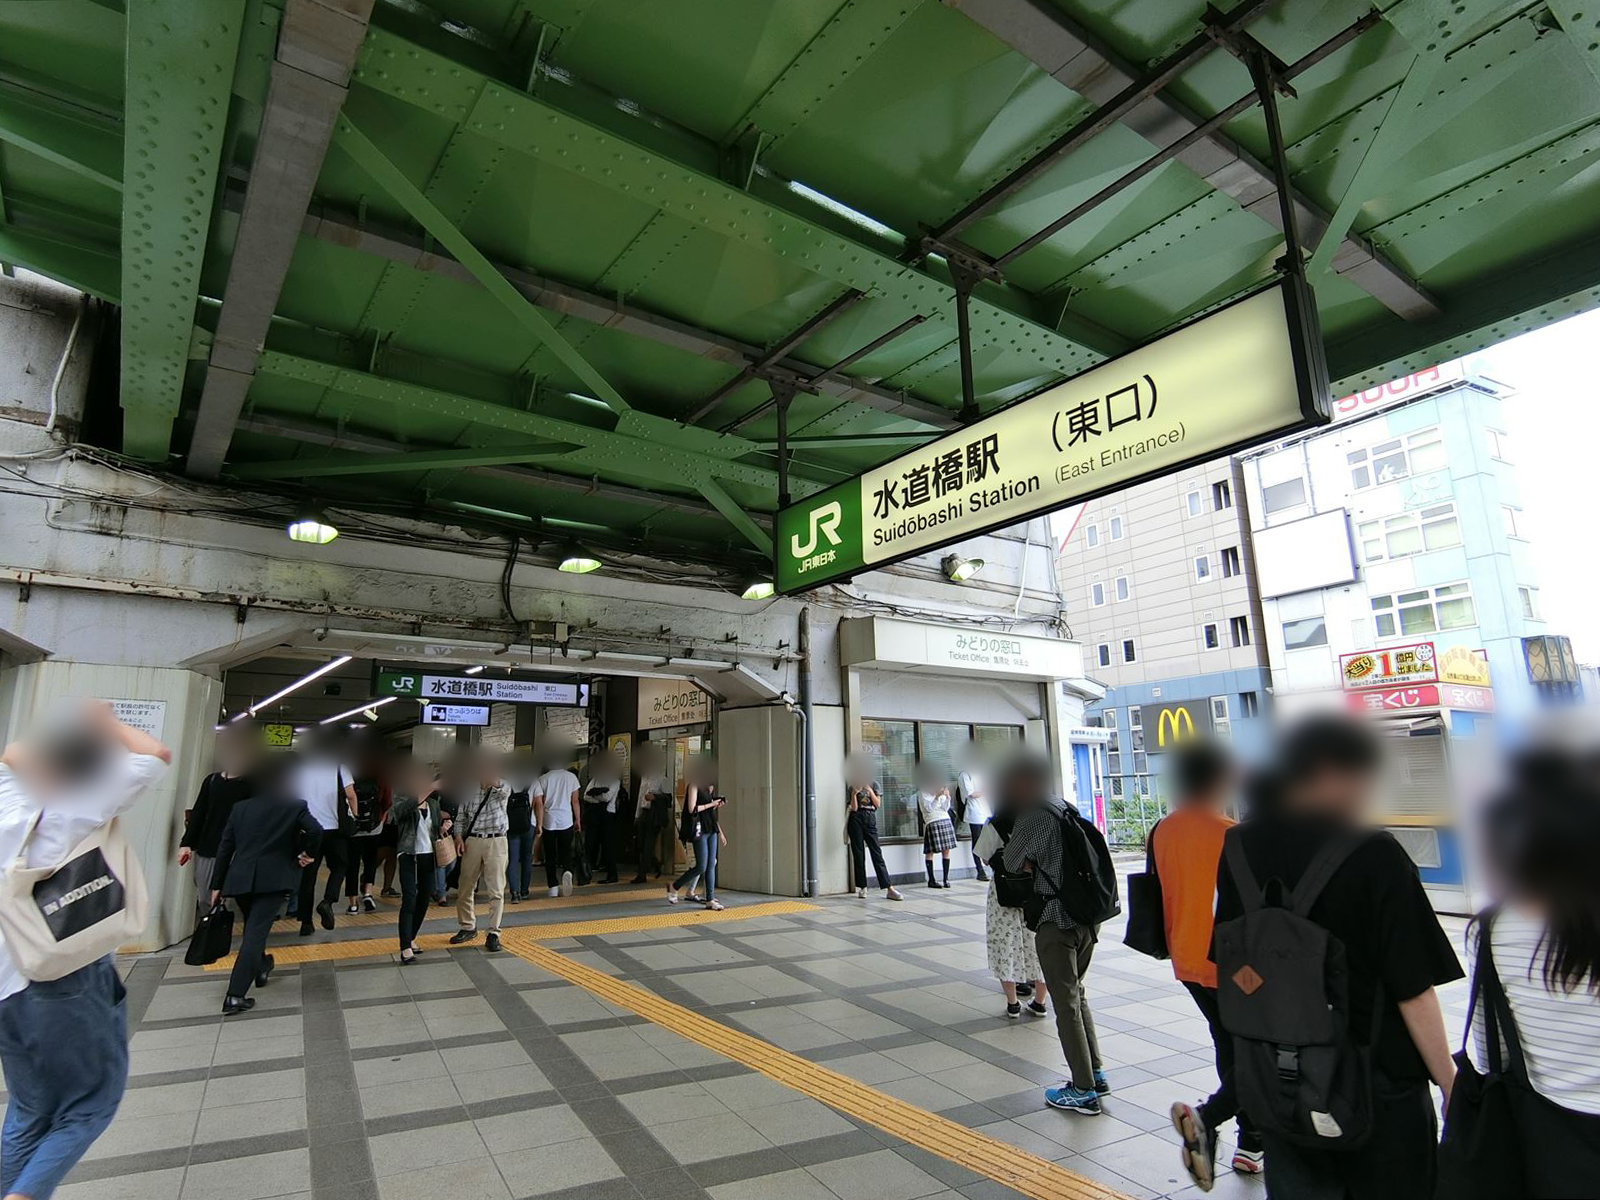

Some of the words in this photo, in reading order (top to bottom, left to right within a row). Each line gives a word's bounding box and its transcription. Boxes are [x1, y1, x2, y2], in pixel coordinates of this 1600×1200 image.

[872, 432, 1000, 520] 水道橋駅
[872, 504, 965, 547] Suidōbashi
[968, 472, 1040, 513] Station
[1054, 452, 1096, 485] (East
[1100, 421, 1186, 471] Entrance)
[791, 501, 842, 558] JR
[797, 549, 837, 575] JR東日本
[956, 634, 1021, 655] みどりの窓口
[948, 651, 969, 662] Ticket
[970, 653, 990, 663] Office
[1345, 656, 1372, 678] 大当り
[392, 676, 414, 689] JR
[430, 678, 493, 697] 水道橋駅
[496, 690, 523, 699] Station
[653, 690, 707, 712] みどりの窓口
[1363, 689, 1420, 710] 宝くじ
[1452, 689, 1485, 707] 宝くじ
[663, 713, 678, 724] Office
